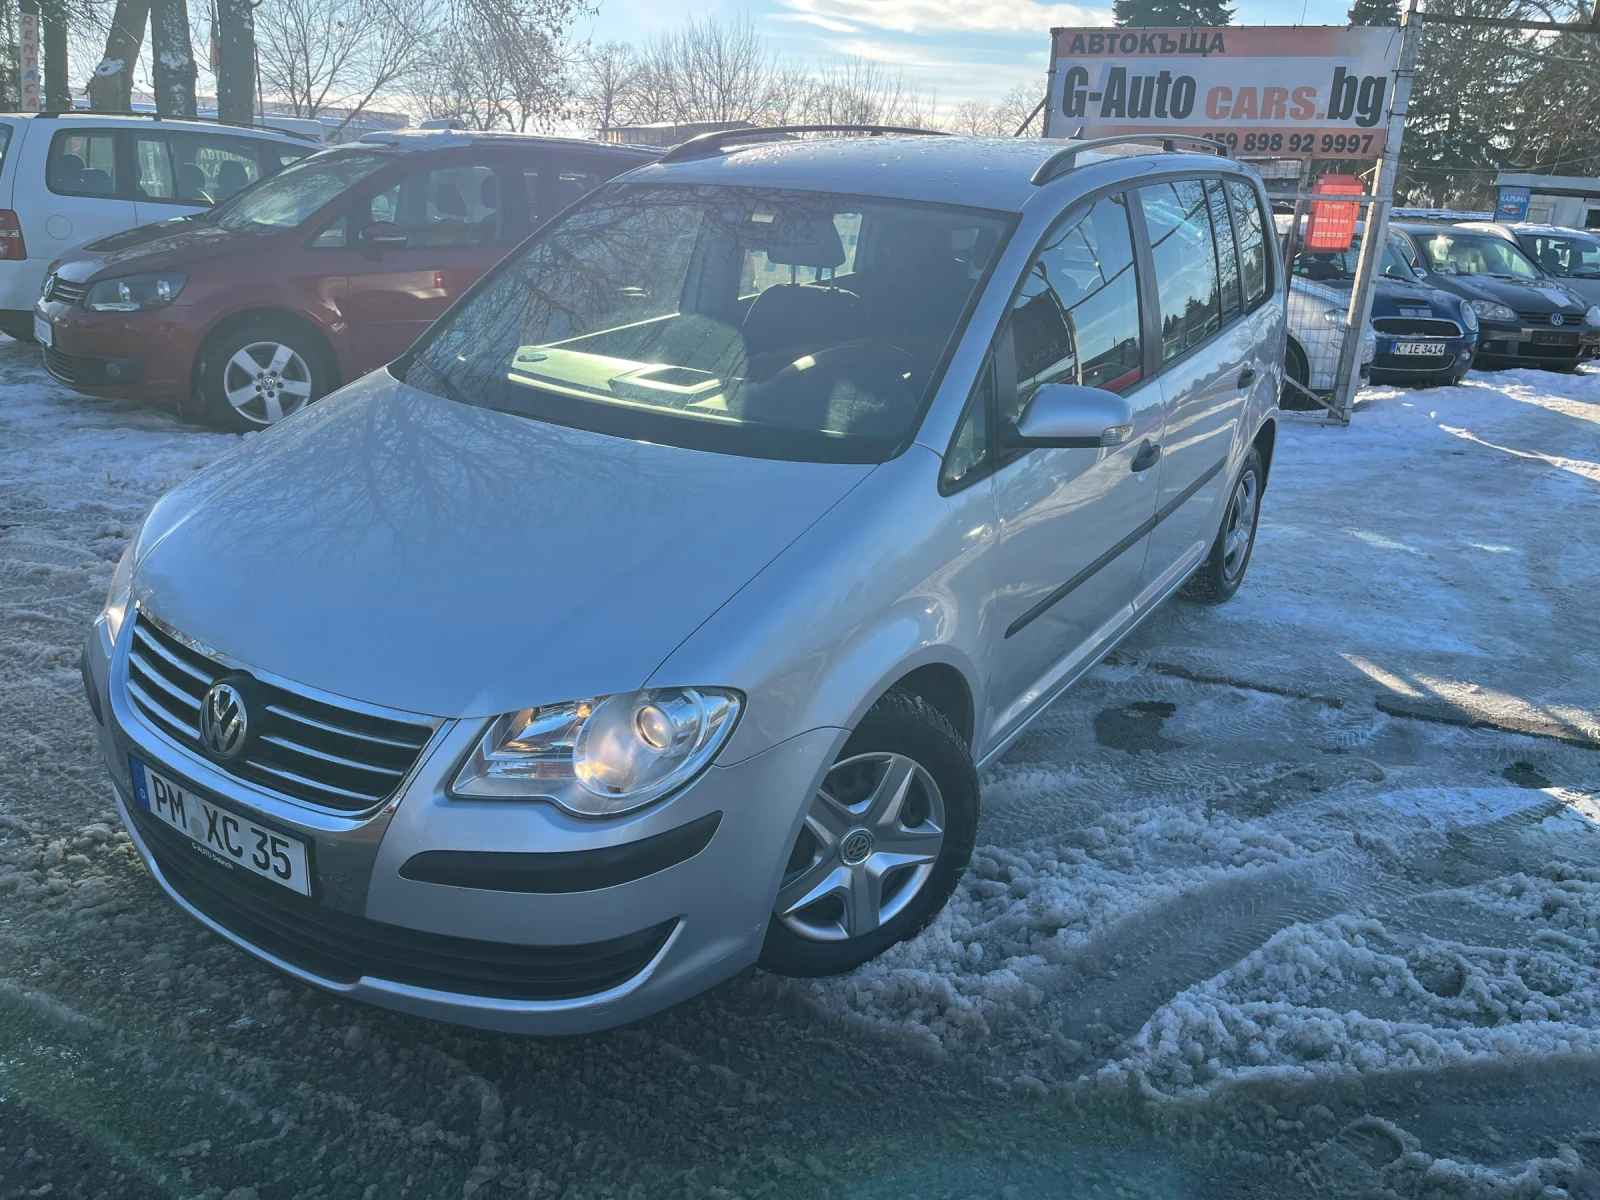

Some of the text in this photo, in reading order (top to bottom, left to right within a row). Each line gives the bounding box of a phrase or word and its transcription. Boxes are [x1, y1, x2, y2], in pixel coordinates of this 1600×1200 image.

[23, 16, 35, 67] RENT
[1069, 32, 1225, 57] АВТОКЪЩА
[25, 70, 36, 80] A
[1062, 66, 1196, 119] G-Auto
[1243, 132, 1283, 151] 898
[1288, 133, 1315, 153] 92
[1320, 134, 1374, 154] 9997
[1395, 343, 1444, 355] K IE 3414
[151, 774, 292, 881] PM XC 35
